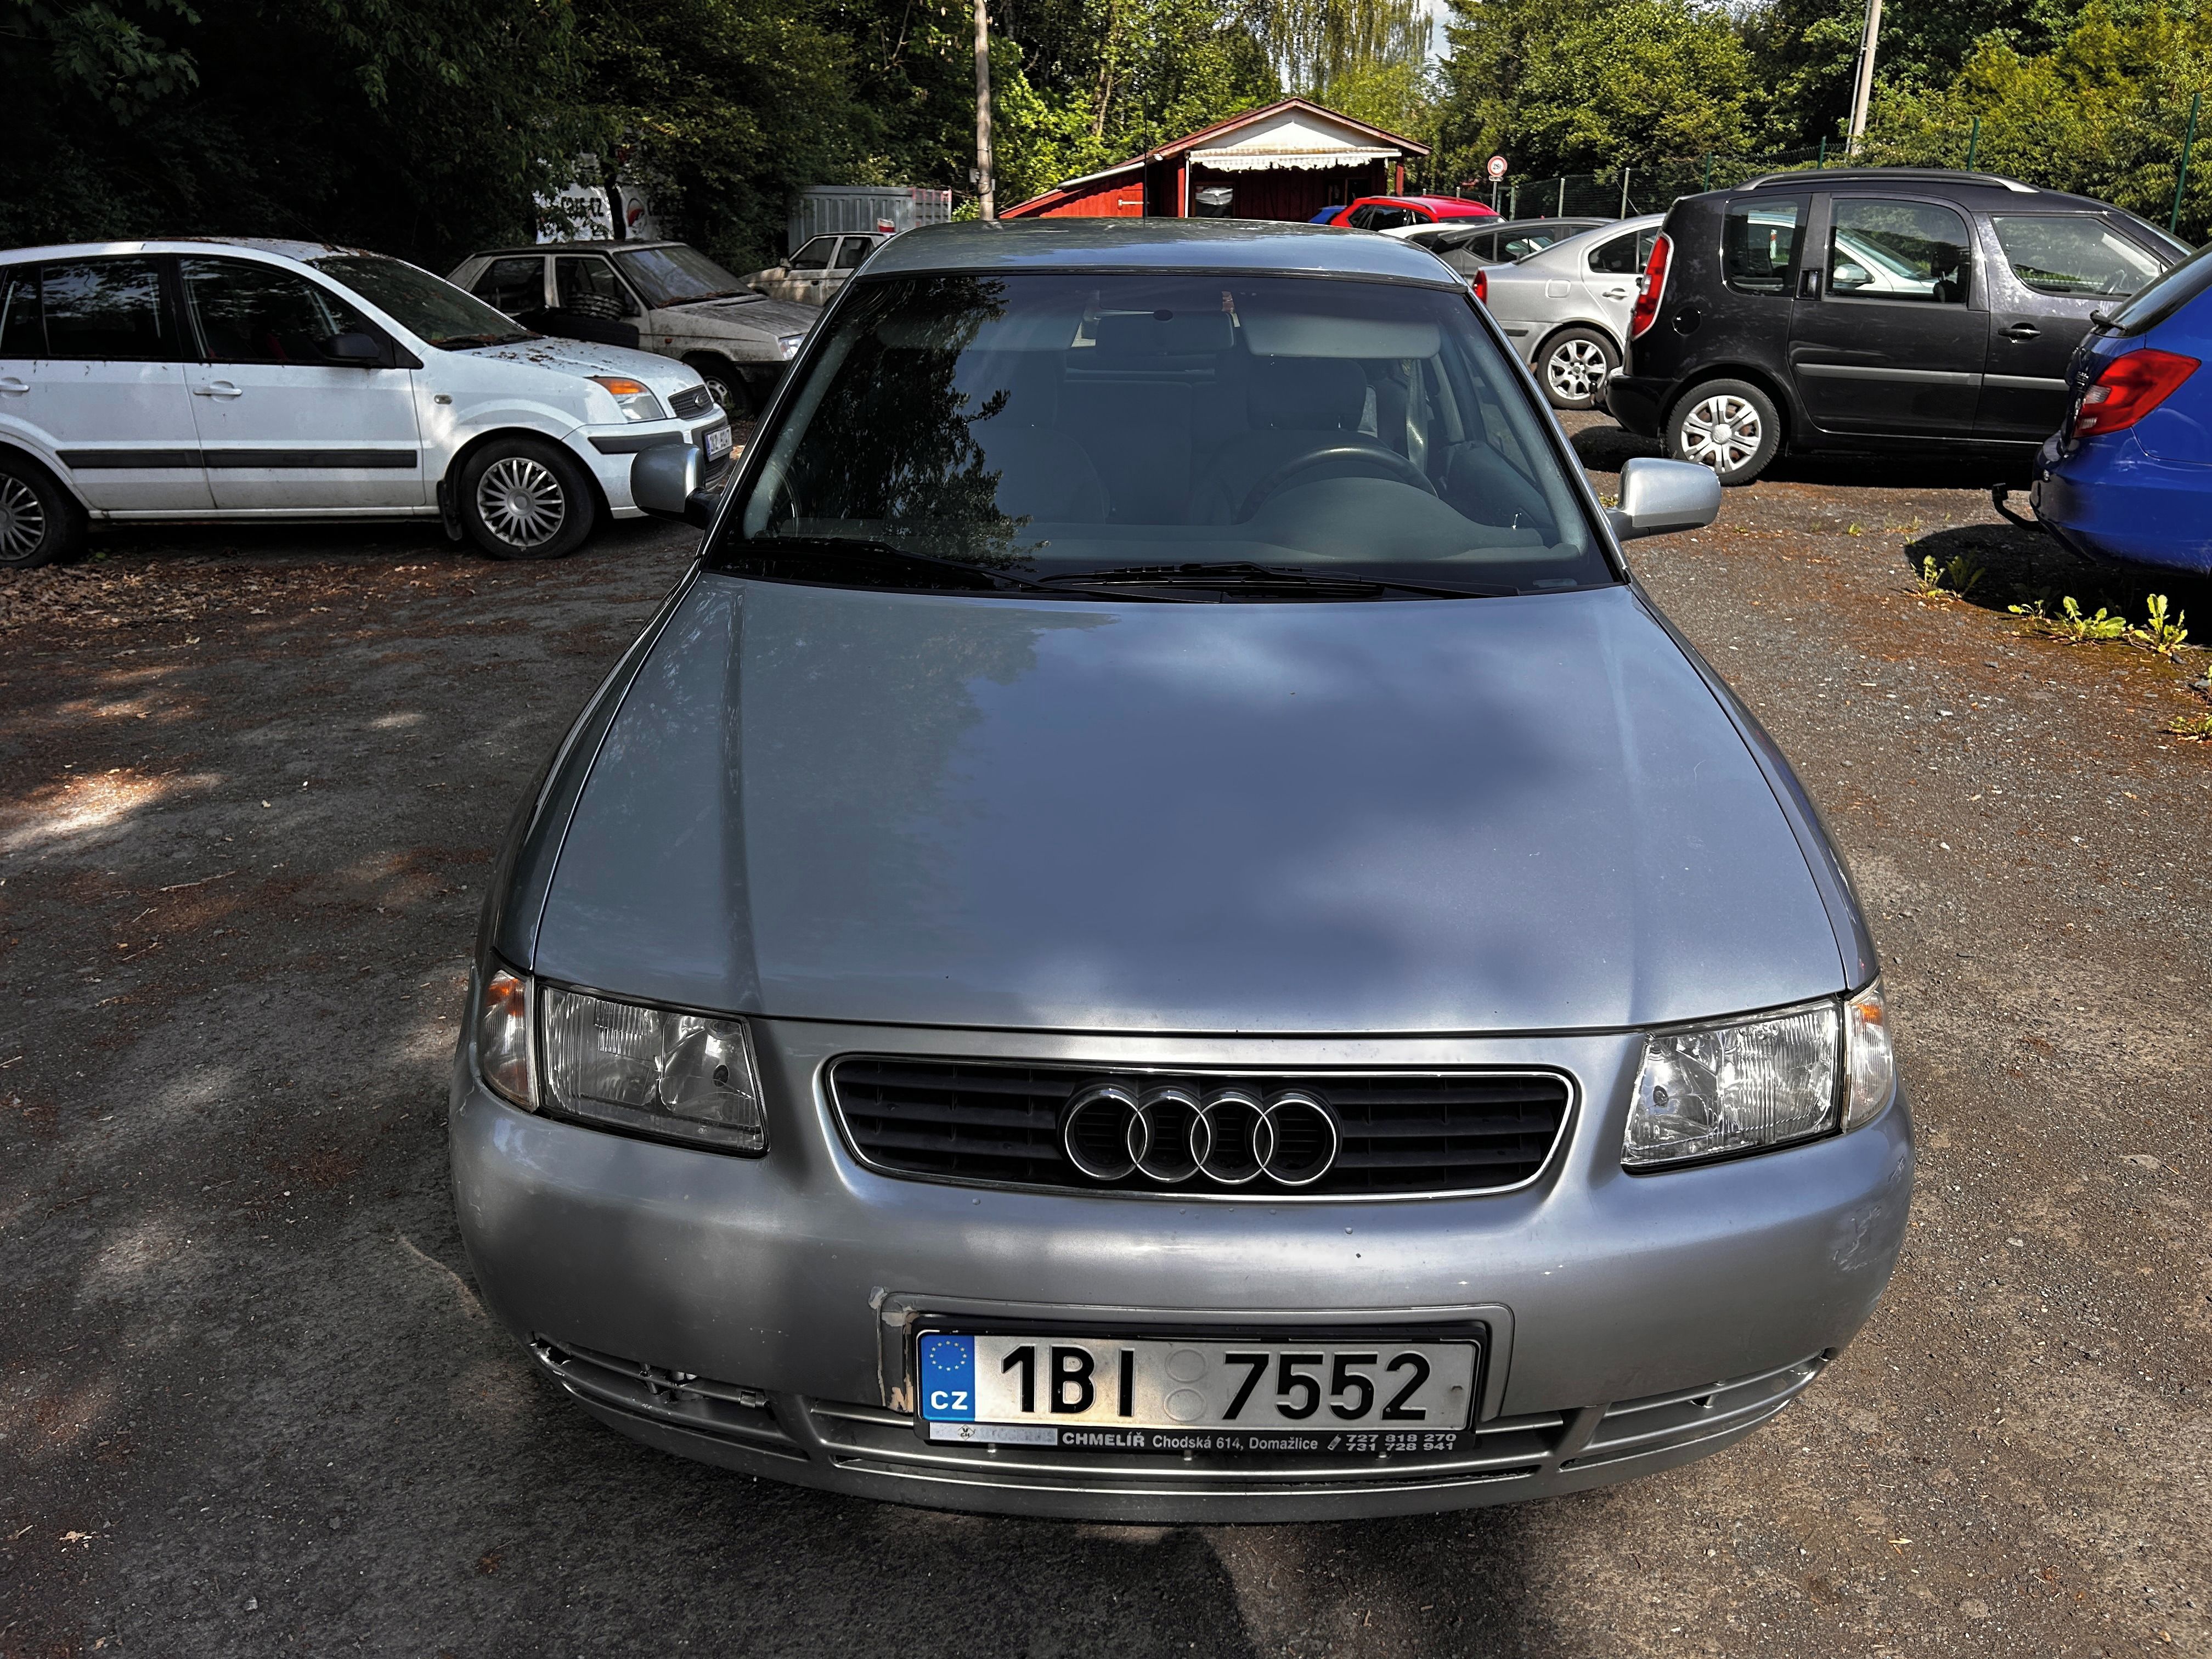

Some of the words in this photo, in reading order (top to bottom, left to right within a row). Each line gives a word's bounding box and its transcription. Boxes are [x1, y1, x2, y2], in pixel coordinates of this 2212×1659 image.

[1001, 1344, 1136, 1418] 1BI
[1221, 1350, 1431, 1421] 7552
[930, 1390, 968, 1410] CZ
[1062, 1431, 1145, 1447] CHMELÍŘ
[1152, 1434, 1212, 1449] Chodská
[1216, 1436, 1244, 1451] 614,
[1249, 1436, 1318, 1450] Domažlice
[1346, 1434, 1379, 1443] 727
[1385, 1434, 1418, 1442] 818
[1424, 1433, 1457, 1442] 270
[1346, 1442, 1376, 1452] 731
[1384, 1442, 1417, 1451] 728
[1423, 1442, 1454, 1451] 941
